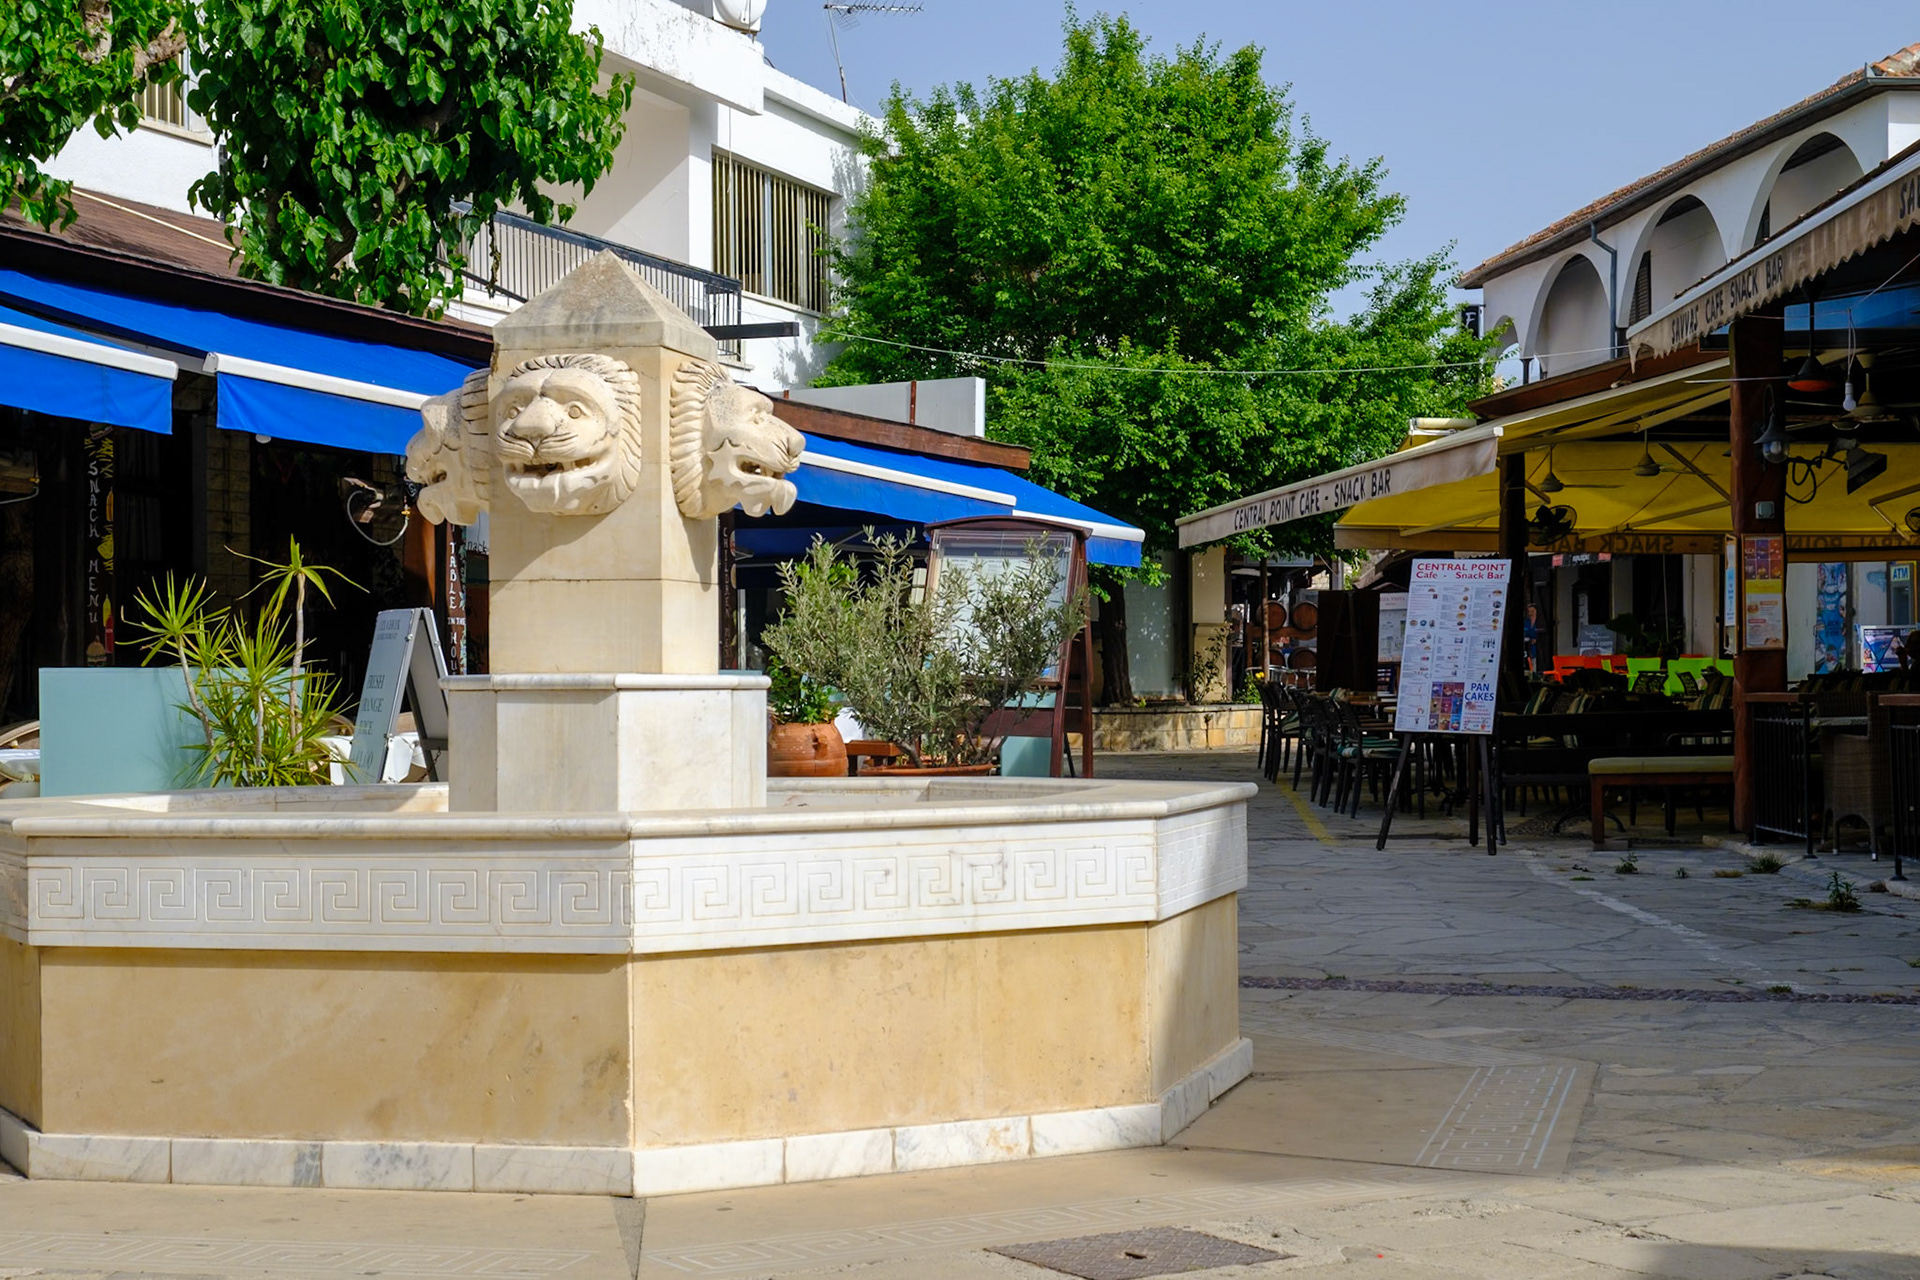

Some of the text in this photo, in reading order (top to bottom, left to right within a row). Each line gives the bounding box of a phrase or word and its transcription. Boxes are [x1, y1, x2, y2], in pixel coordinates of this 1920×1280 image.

[1671, 254, 1784, 345] SAVVAS CAFE SNACK BAR
[1234, 502, 1266, 531] CENTRAL
[1268, 496, 1296, 522] POINT
[1299, 488, 1320, 516] CAFE
[1334, 476, 1366, 508] SNACK
[1371, 468, 1391, 497] BAR
[88, 460, 101, 624] SNACK MENU
[468, 540, 488, 552] nack
[449, 542, 458, 610] TABLE
[1892, 567, 1908, 580] ATM
[450, 632, 458, 676] HOU
[1464, 692, 1494, 701] CAKES
[1471, 682, 1490, 691] PAN
